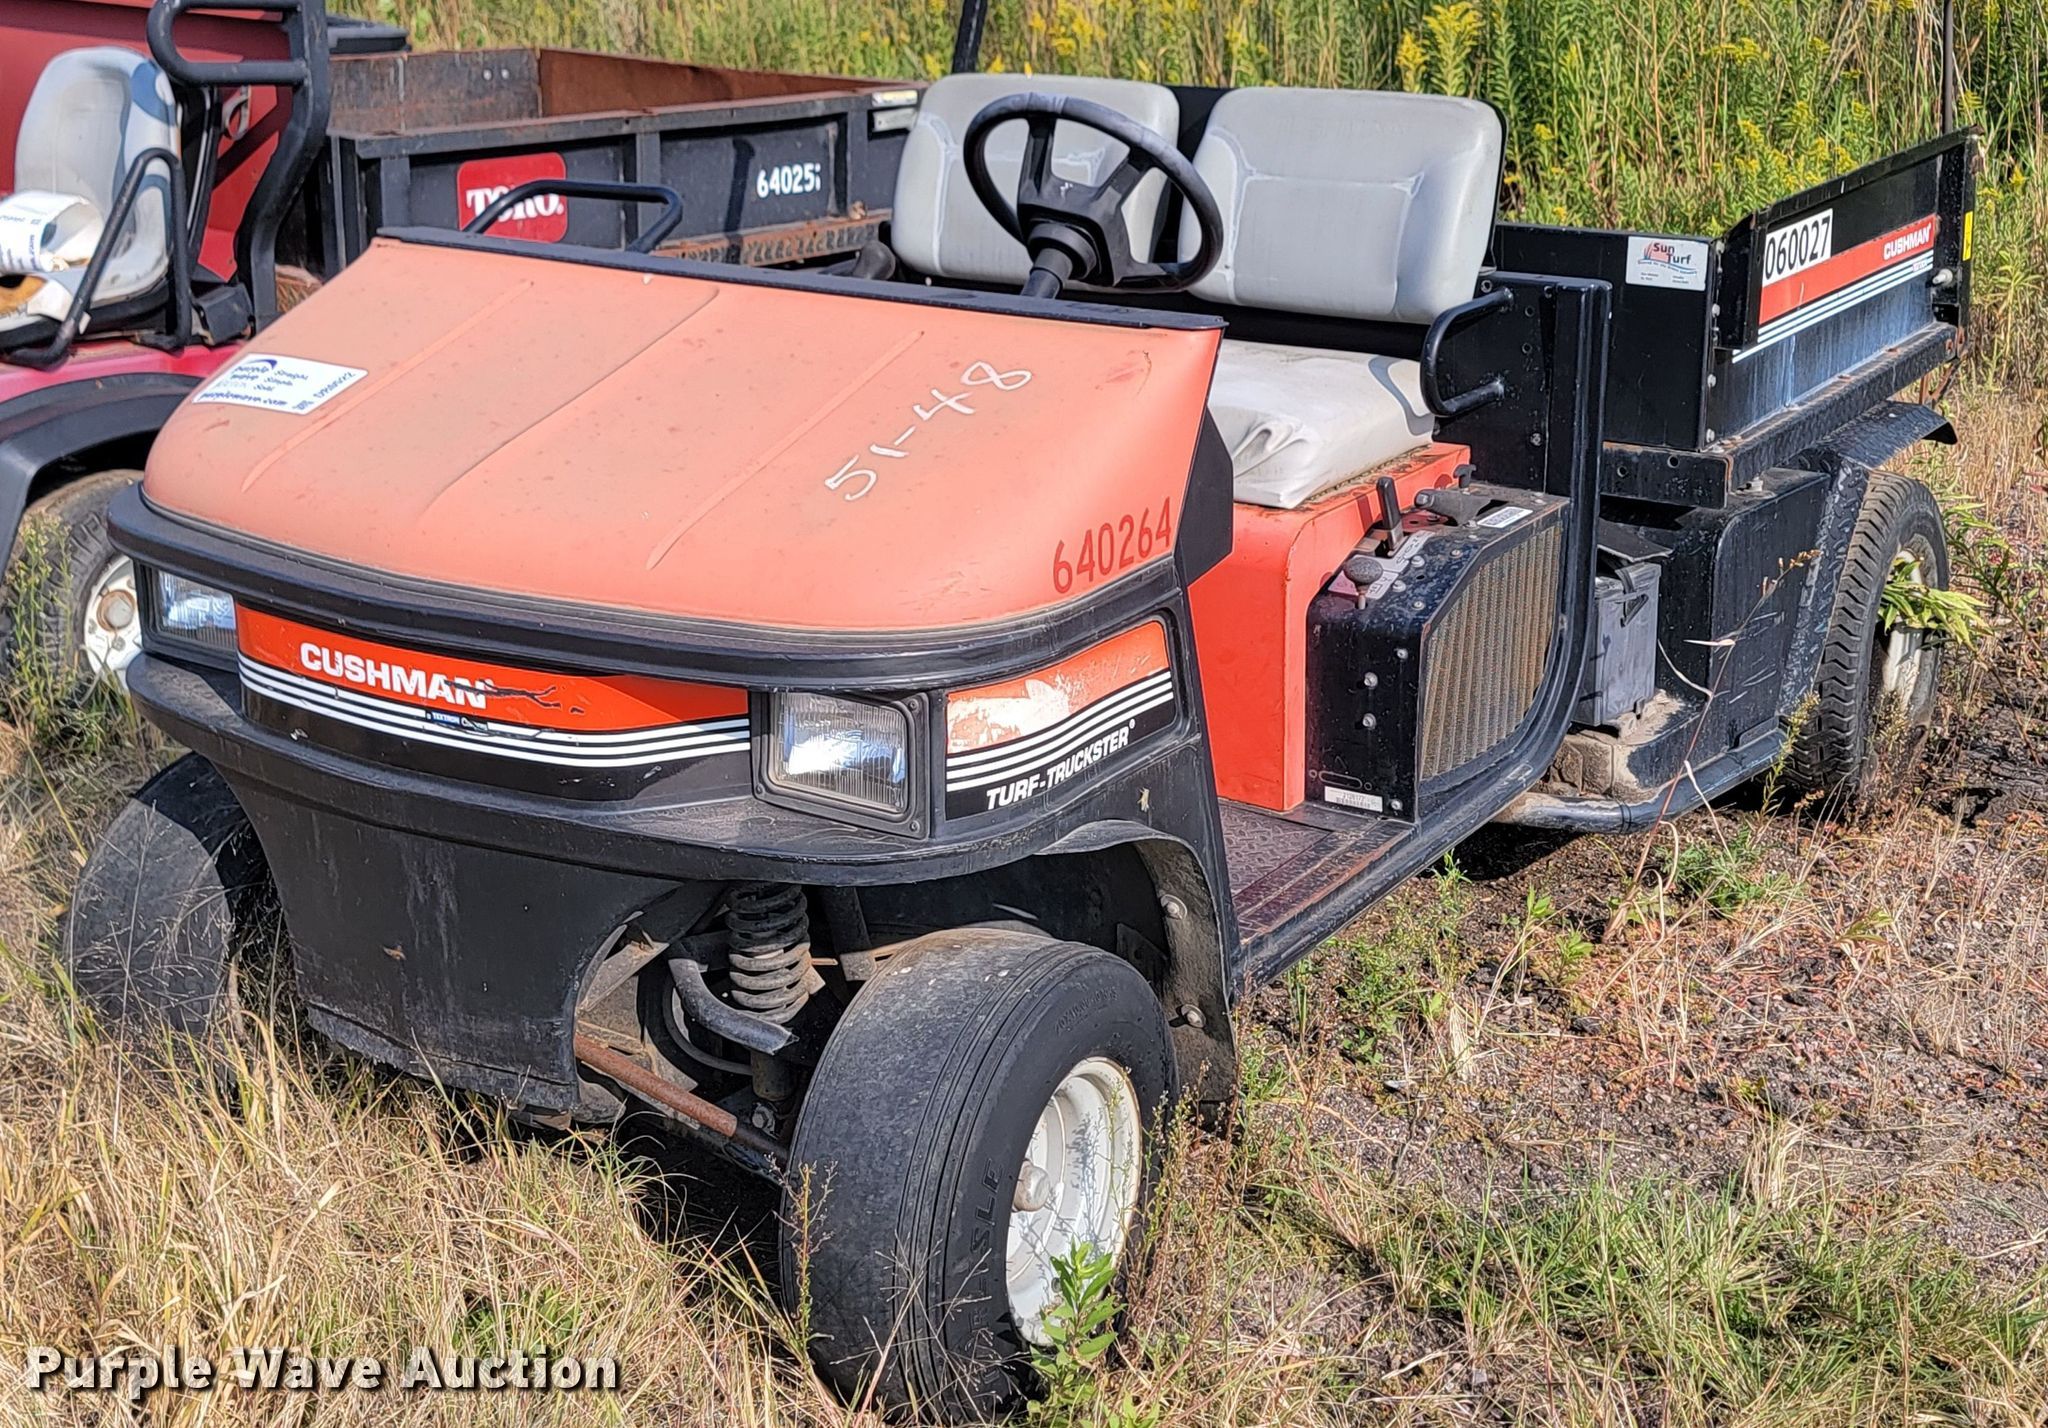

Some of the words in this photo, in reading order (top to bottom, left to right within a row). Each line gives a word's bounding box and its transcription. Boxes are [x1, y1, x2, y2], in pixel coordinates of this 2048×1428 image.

[1653, 242, 1675, 253] Sun
[1666, 253, 1691, 265] Turf
[1765, 215, 1831, 280] 060027
[1883, 225, 1931, 260] CUSHMAN
[824, 360, 1033, 500] 51-48
[1053, 496, 1172, 594] 640264
[300, 642, 489, 709] CUSHMAN
